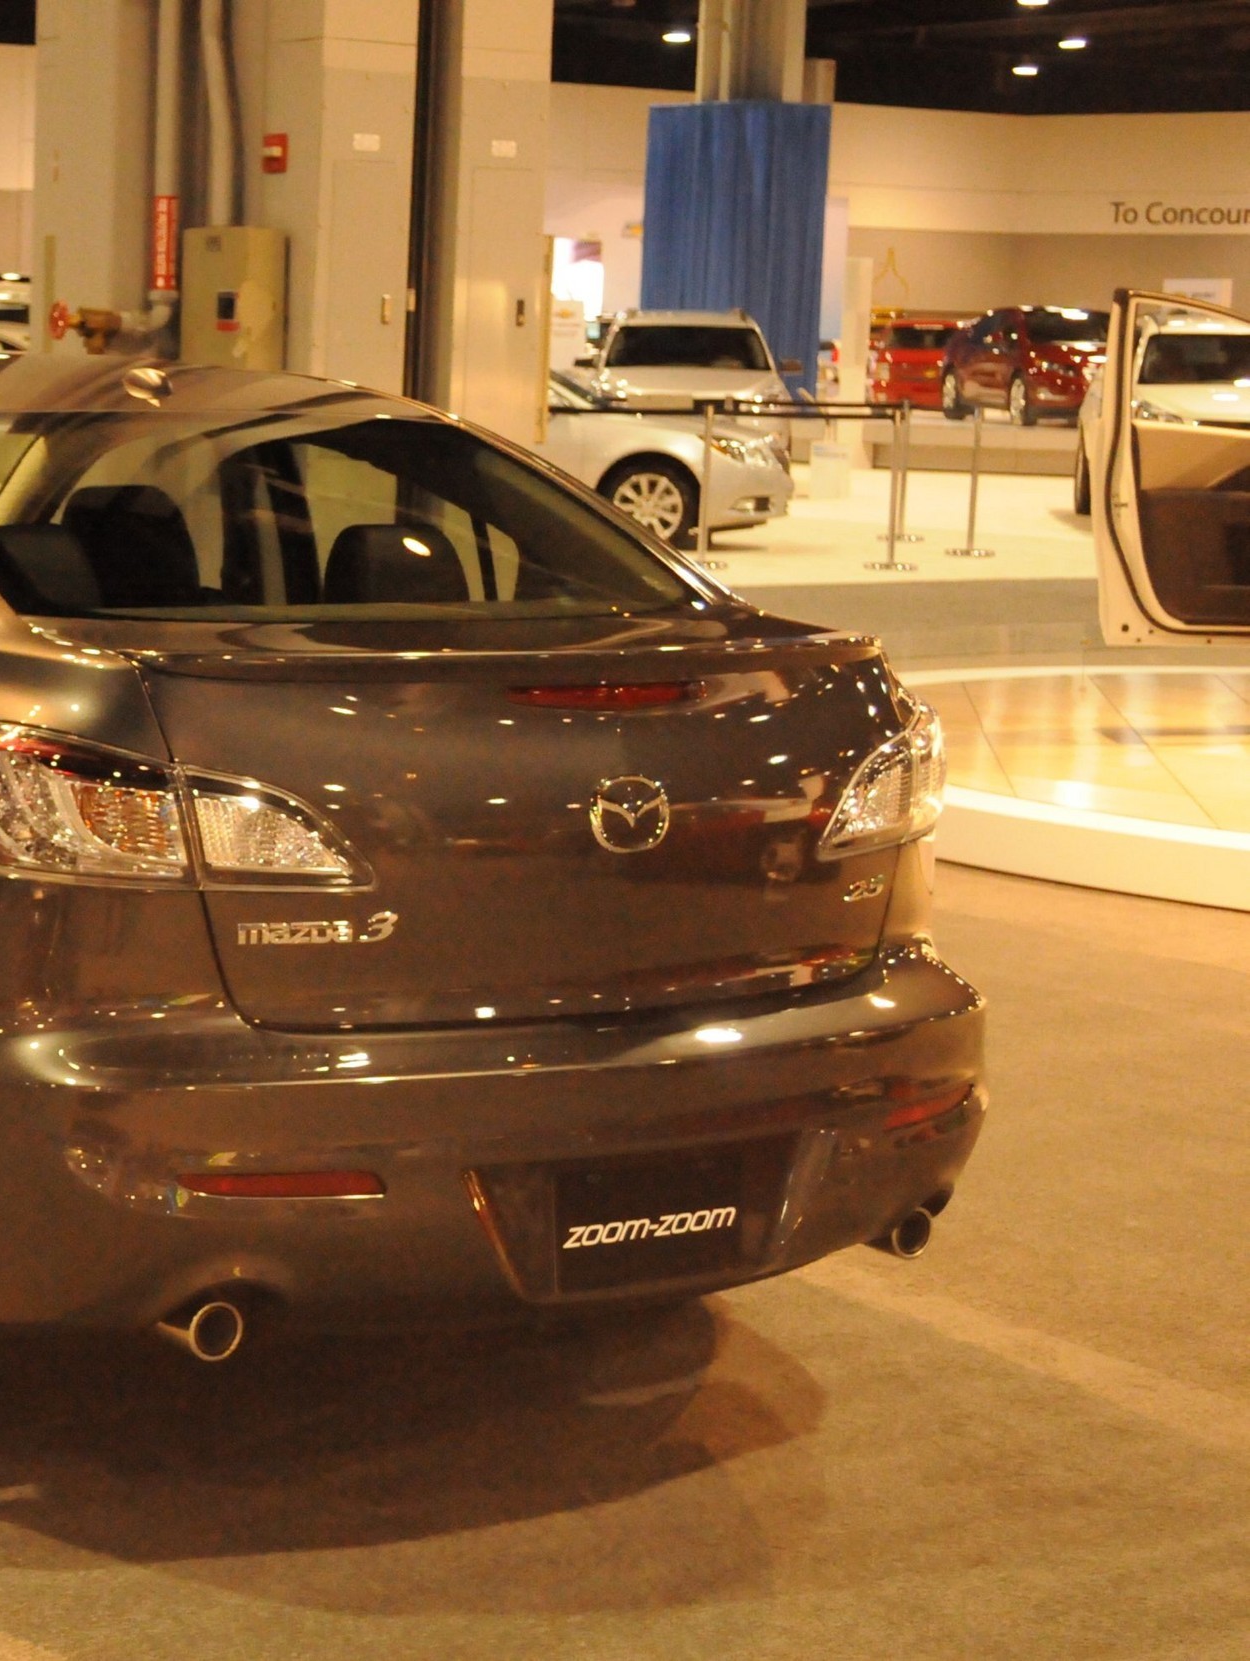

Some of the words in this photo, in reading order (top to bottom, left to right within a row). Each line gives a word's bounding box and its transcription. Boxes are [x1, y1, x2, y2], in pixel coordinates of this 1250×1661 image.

[1111, 201, 1138, 224] To
[357, 911, 399, 943] 3
[562, 1206, 737, 1249] zoom-zoom
